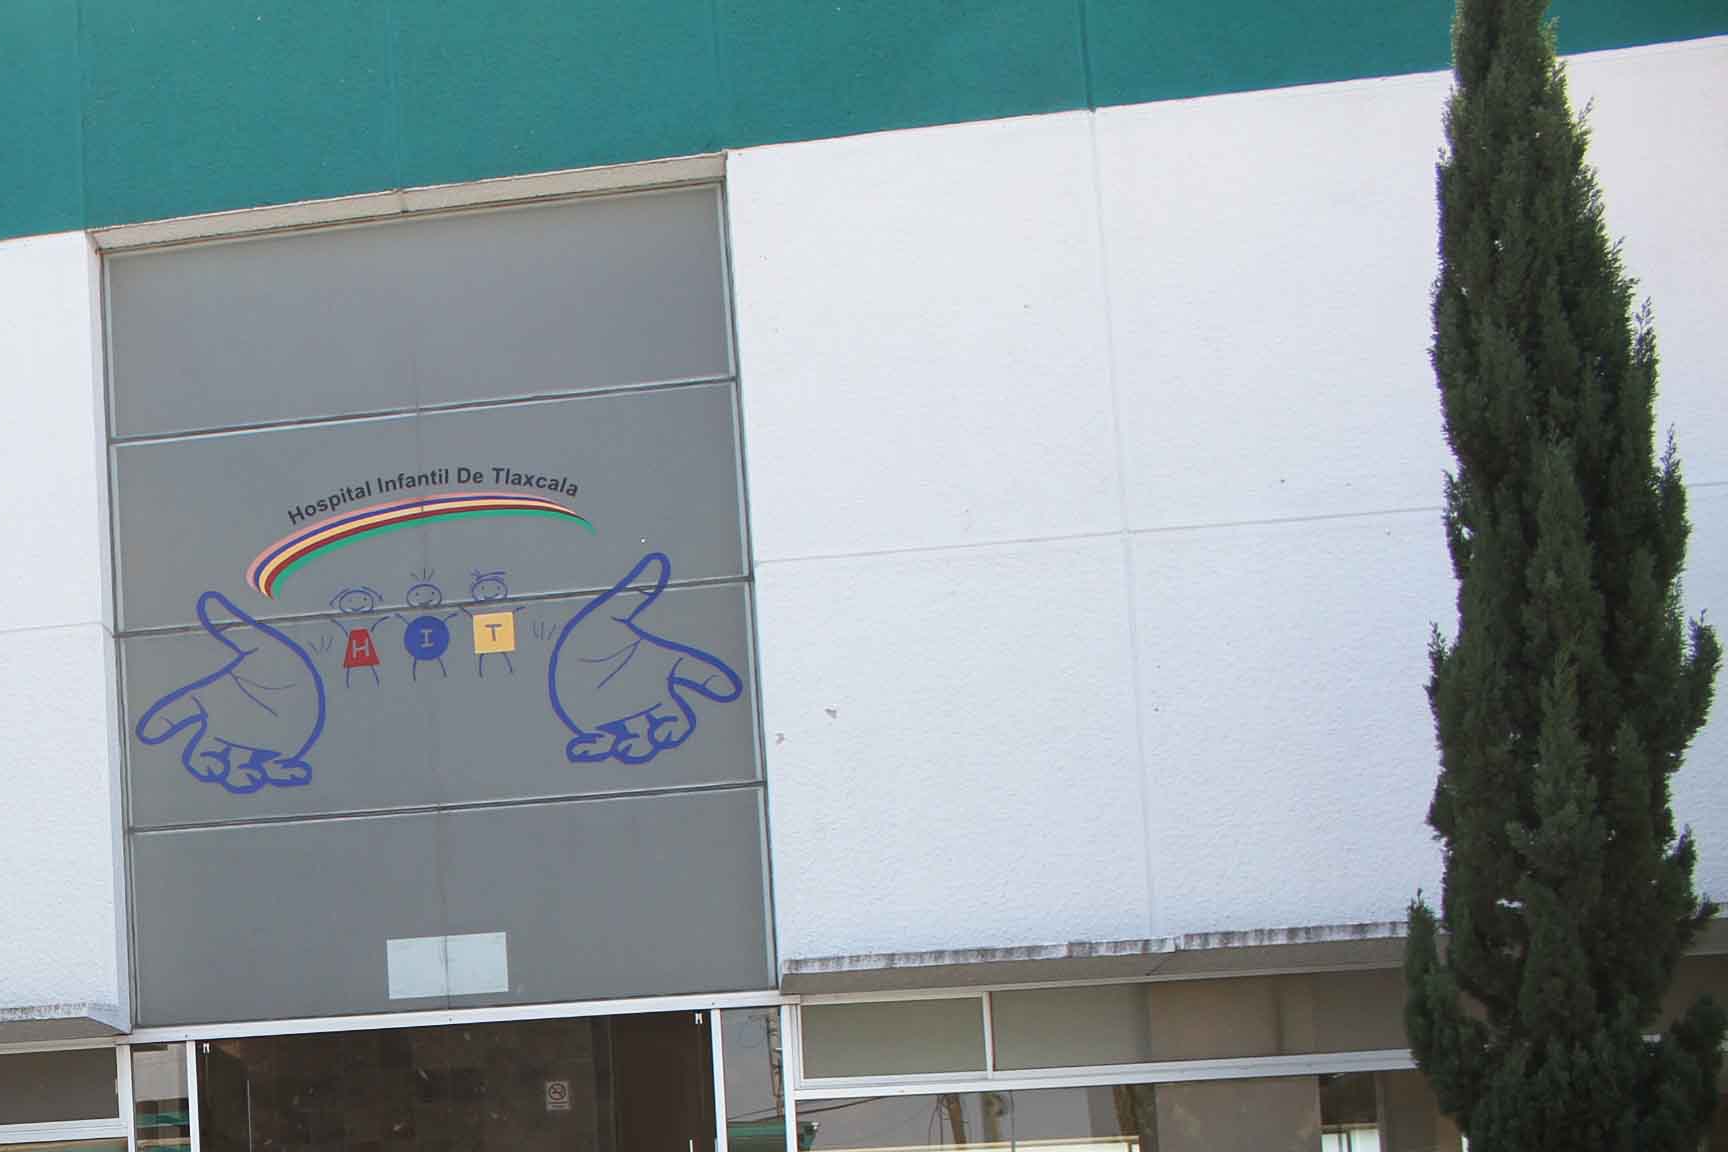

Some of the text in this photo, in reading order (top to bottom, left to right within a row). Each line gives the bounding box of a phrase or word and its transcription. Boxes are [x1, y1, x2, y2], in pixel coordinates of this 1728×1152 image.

[287, 467, 579, 525] Hospital Infantil De Tlaxcala
